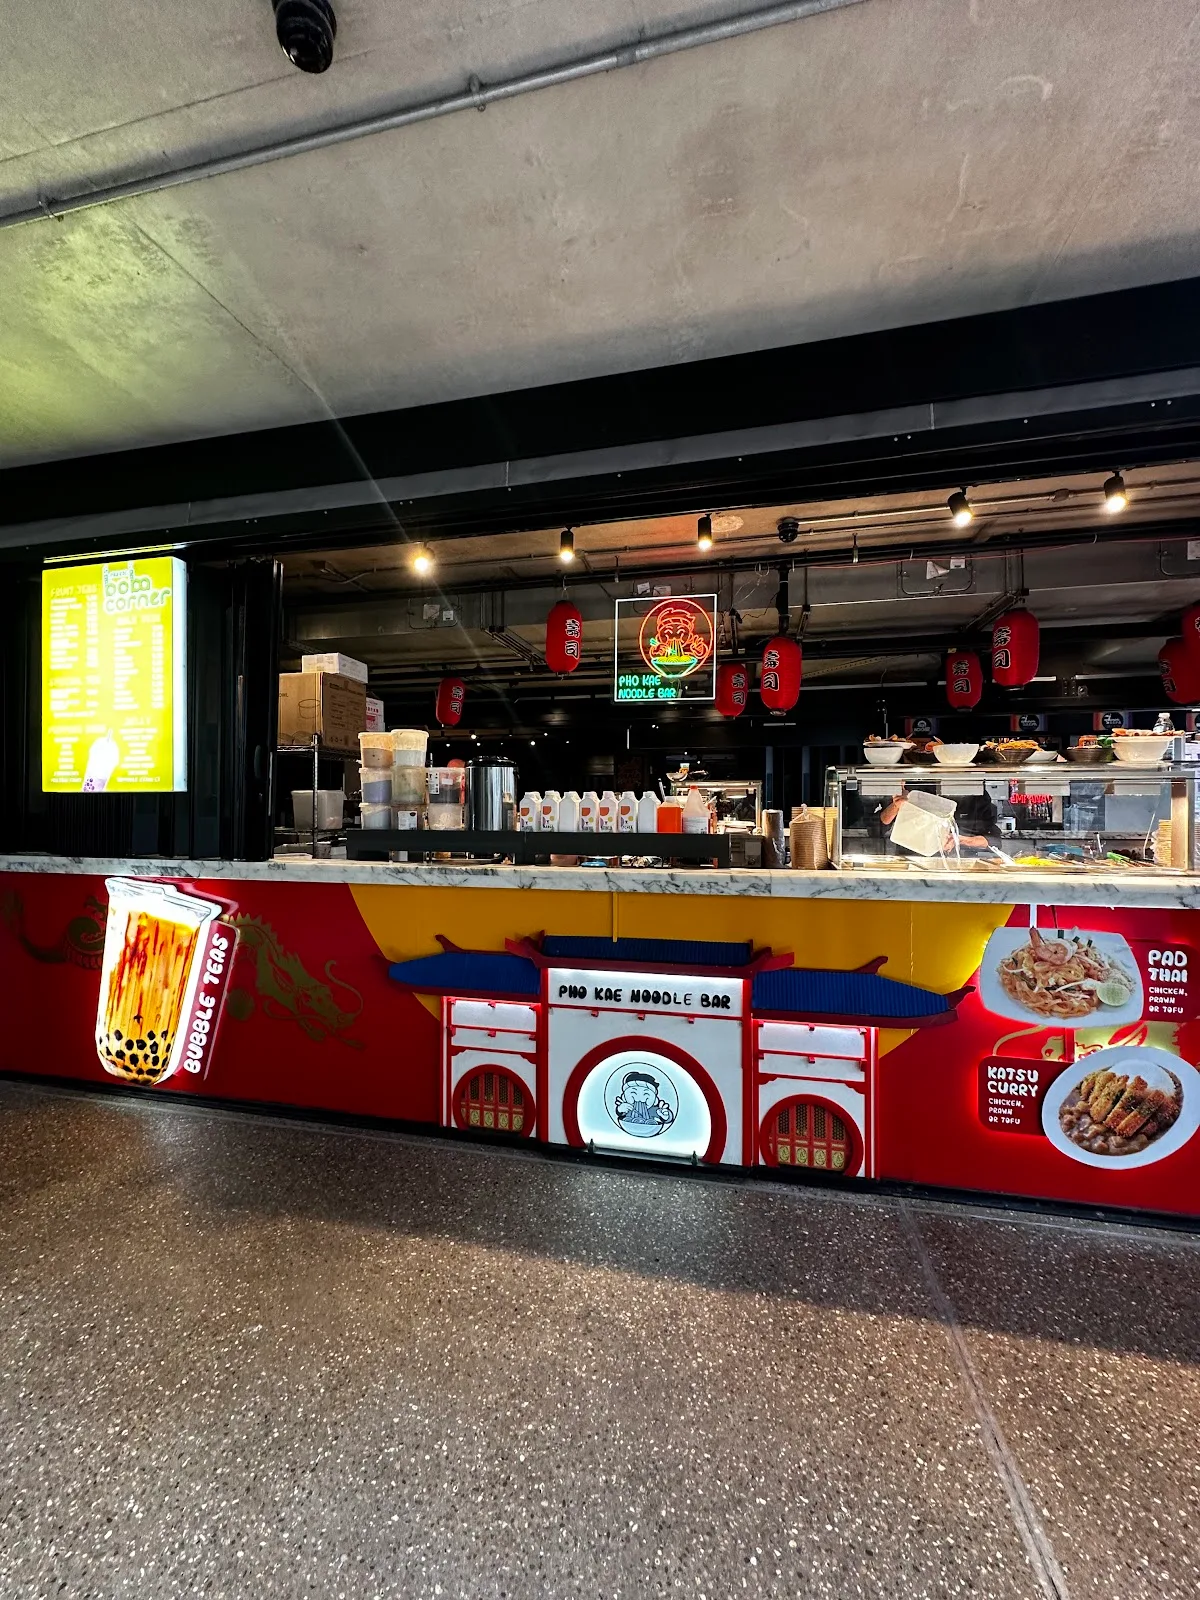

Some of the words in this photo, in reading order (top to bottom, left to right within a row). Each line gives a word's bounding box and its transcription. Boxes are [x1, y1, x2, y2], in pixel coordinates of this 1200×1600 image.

[105, 589, 171, 612] corner
[618, 674, 639, 687] PHO
[642, 674, 662, 687] KAE
[618, 688, 655, 699] NOODLE
[657, 687, 677, 698] BAR
[1147, 949, 1188, 968] PAD
[1147, 967, 1188, 983] THAI
[558, 984, 588, 1000] PHO
[594, 986, 623, 1002] KAE
[630, 989, 693, 1006] NOODLE
[700, 993, 731, 1010] BAR
[1148, 986, 1189, 997] CHICKEN,
[183, 994, 216, 1074] BUBBLE
[203, 932, 229, 985] TEAS
[1148, 996, 1176, 1005] PRAWN
[1148, 1005, 1160, 1013] OR
[1163, 1005, 1184, 1014] TOFU
[987, 1065, 1039, 1083] KATSU
[987, 1080, 1038, 1098] CURRY
[988, 1097, 1024, 1108] CHICKEN,
[988, 1107, 1013, 1116] PRAWN
[988, 1116, 999, 1124] OR
[1001, 1116, 1021, 1125] TOFU
